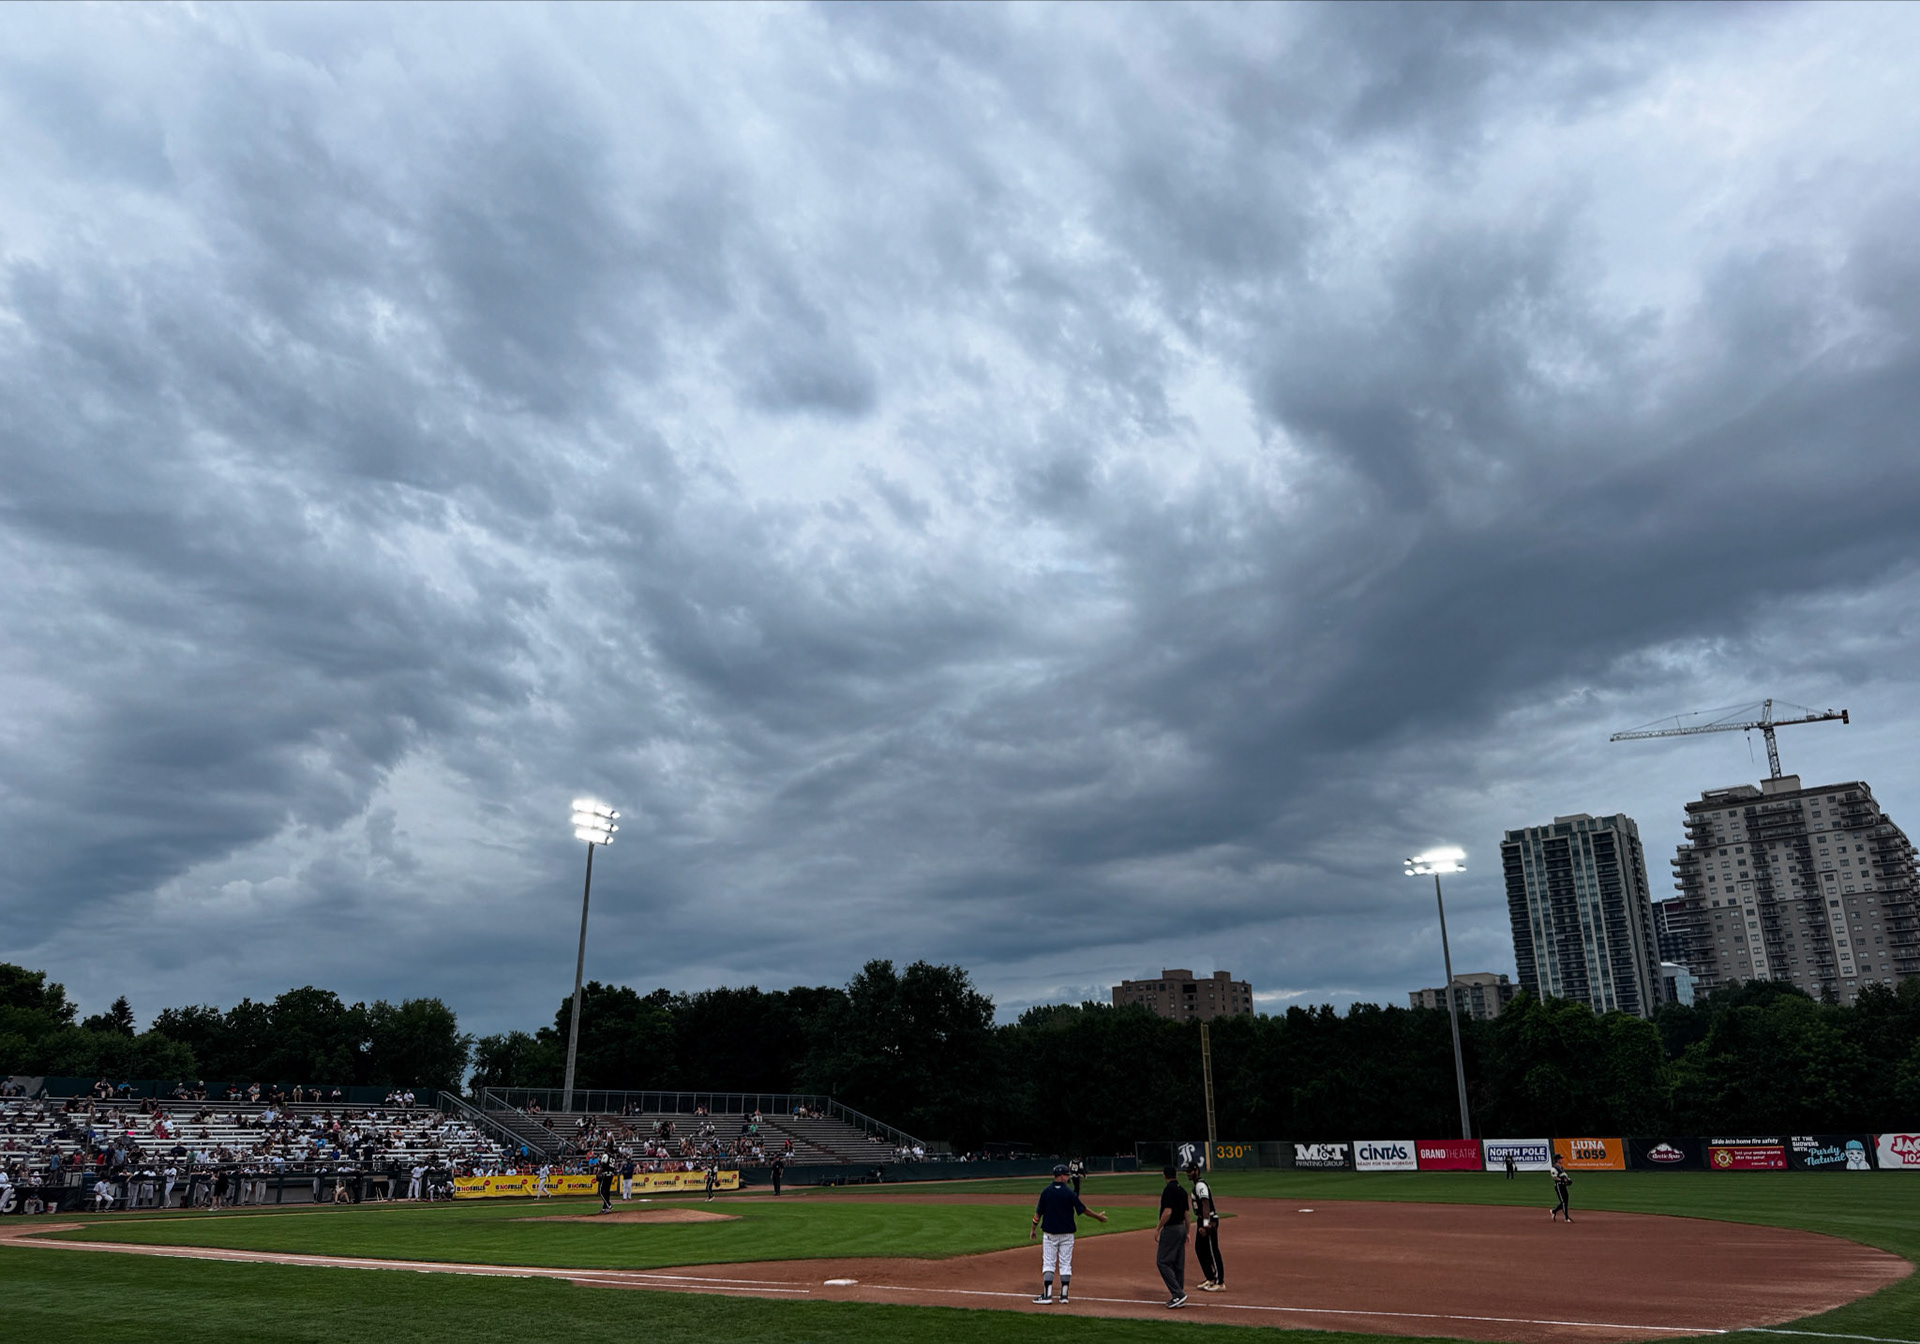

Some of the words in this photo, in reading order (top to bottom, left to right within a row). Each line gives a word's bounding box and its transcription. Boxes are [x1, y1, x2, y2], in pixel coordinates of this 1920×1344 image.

[1216, 1145, 1244, 1159] 330
[1294, 1143, 1348, 1160] M&T
[1490, 1148, 1520, 1156] NORTH
[1522, 1148, 1546, 1156] POLE
[1576, 1150, 1606, 1159] 1059
[1808, 1146, 1840, 1157] Purdy
[1804, 1152, 1846, 1166] Natural
